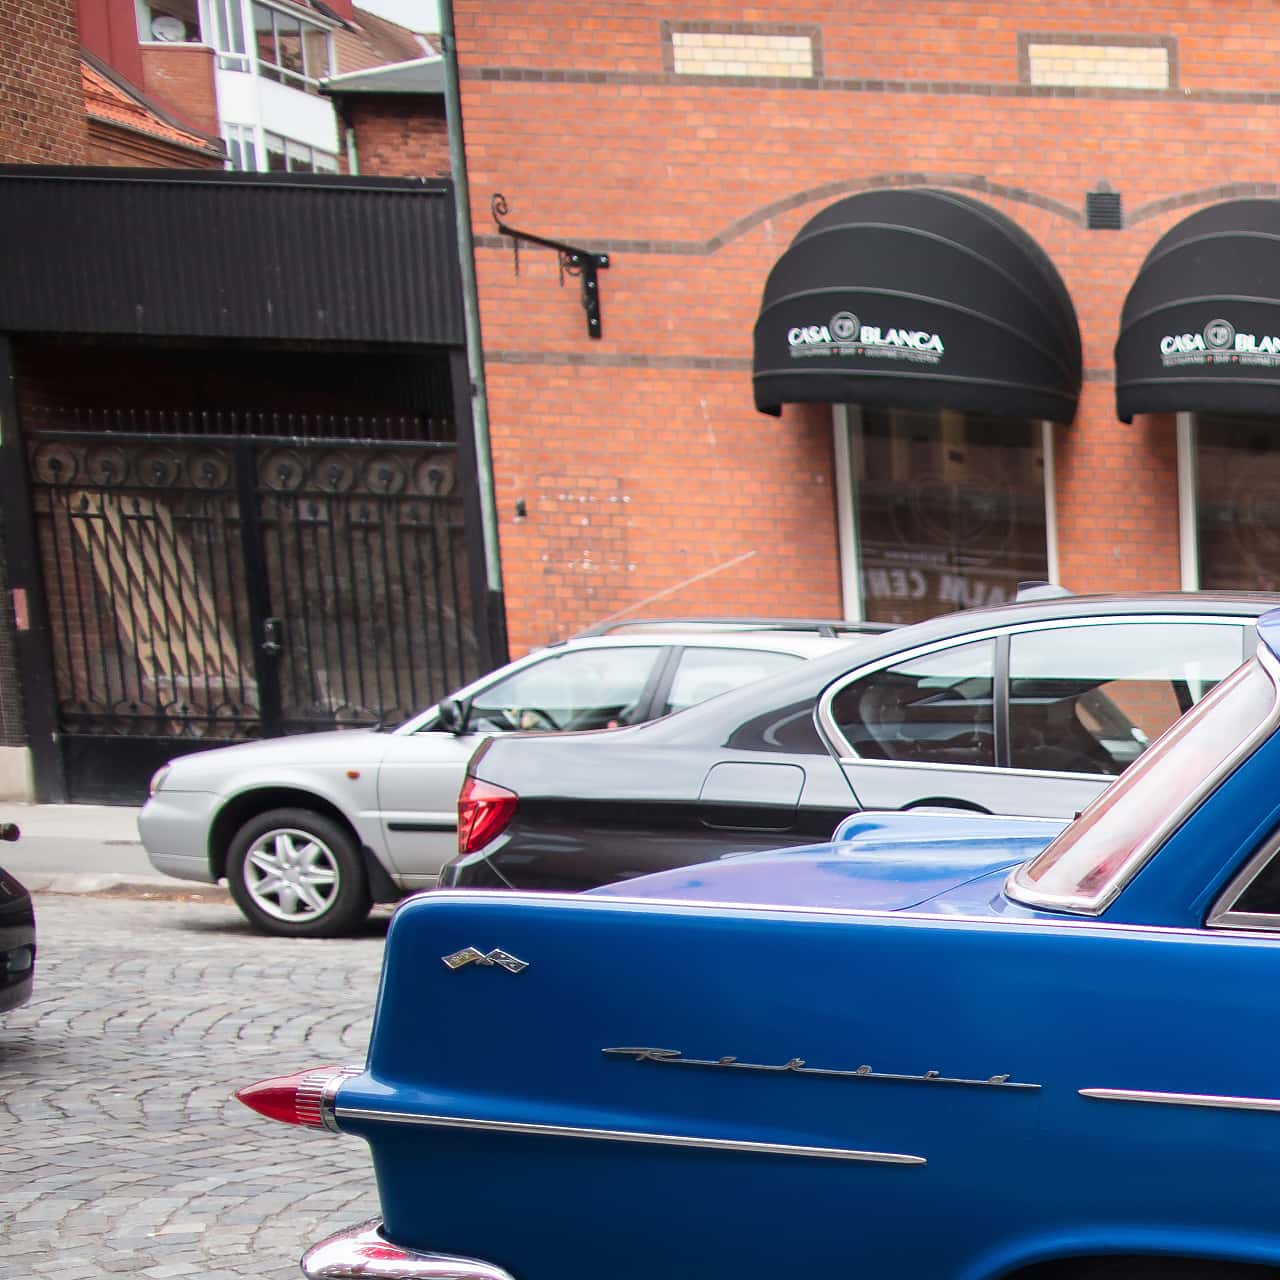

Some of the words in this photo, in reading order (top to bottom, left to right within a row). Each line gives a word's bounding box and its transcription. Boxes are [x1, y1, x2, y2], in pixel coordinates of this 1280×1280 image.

[787, 326, 832, 346] CASA
[860, 326, 945, 353] BLANCA
[1160, 334, 1206, 355] CASA
